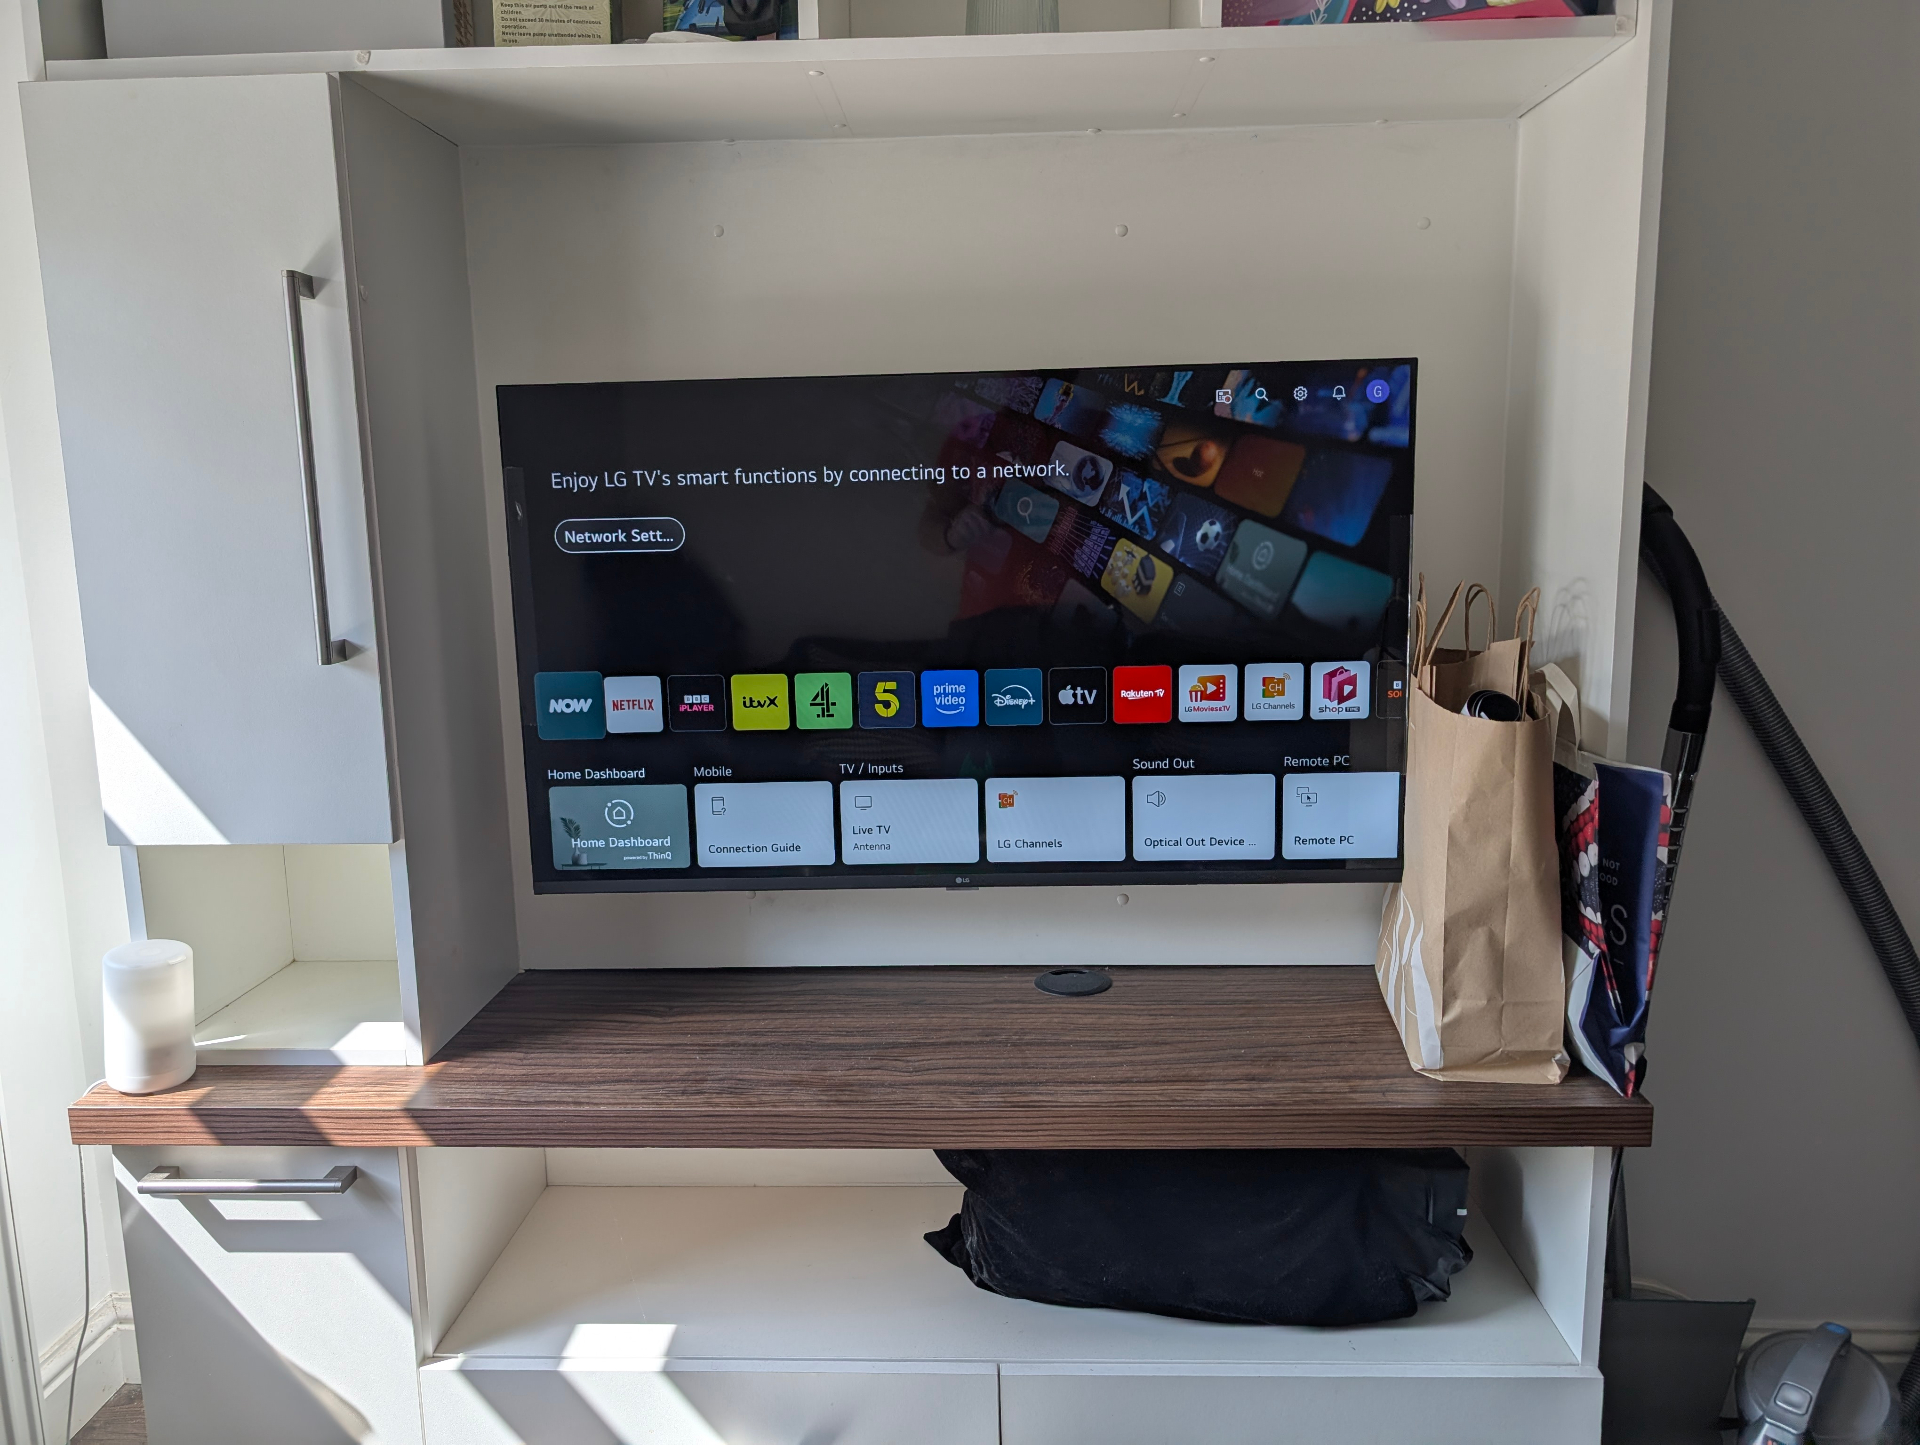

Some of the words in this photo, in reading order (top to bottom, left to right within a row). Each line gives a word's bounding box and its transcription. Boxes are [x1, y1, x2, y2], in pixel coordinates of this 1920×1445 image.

[1373, 386, 1382, 398] G
[551, 471, 598, 492] Enjoy
[604, 471, 627, 487] LG
[632, 469, 671, 487] TV's
[677, 470, 729, 486] smart
[734, 467, 817, 485] functions
[823, 466, 843, 486] by
[849, 464, 946, 484] connecting
[951, 465, 970, 480] to
[976, 466, 987, 479] a
[993, 460, 1070, 478] network.
[564, 529, 627, 544] Network
[631, 529, 674, 543] Sett...
[933, 683, 966, 697] prime
[1268, 683, 1282, 692] CH
[685, 695, 709, 703] BBC
[810, 682, 836, 718] 4
[874, 681, 899, 718] 5
[934, 695, 966, 706] video
[1076, 686, 1097, 705] tv
[1120, 689, 1154, 700] Rakuten
[549, 698, 592, 714] NOW
[612, 698, 654, 712] NETFLIX
[680, 704, 714, 712] iPLAYER
[742, 695, 779, 709] itvX
[1251, 702, 1262, 711] LG
[1263, 701, 1295, 711] Channels
[1318, 704, 1344, 715] shop
[1132, 758, 1170, 770] Sound
[1173, 758, 1195, 769] Out
[1284, 756, 1330, 768] Remote
[1333, 755, 1350, 766] PC
[547, 769, 582, 780] Home
[585, 767, 645, 779] Dashboard
[694, 766, 732, 778] Mobile
[839, 763, 855, 775] TV
[868, 762, 904, 776] Inputs
[852, 825, 874, 835] Live
[876, 825, 891, 835] TV
[571, 837, 606, 849] Home
[609, 836, 671, 848] Dashboard
[853, 842, 891, 851] Antenna
[997, 839, 1011, 849] LG
[1014, 838, 1063, 848] Channels
[1144, 837, 1182, 849] Optical
[1186, 836, 1206, 847] Out
[1210, 836, 1245, 847] Device
[1294, 835, 1336, 846] Remote
[1339, 835, 1354, 845] PC
[708, 843, 768, 854] Connection
[771, 841, 801, 853] Guide
[647, 851, 672, 860] ThinQ
[1602, 858, 1620, 871] NOT
